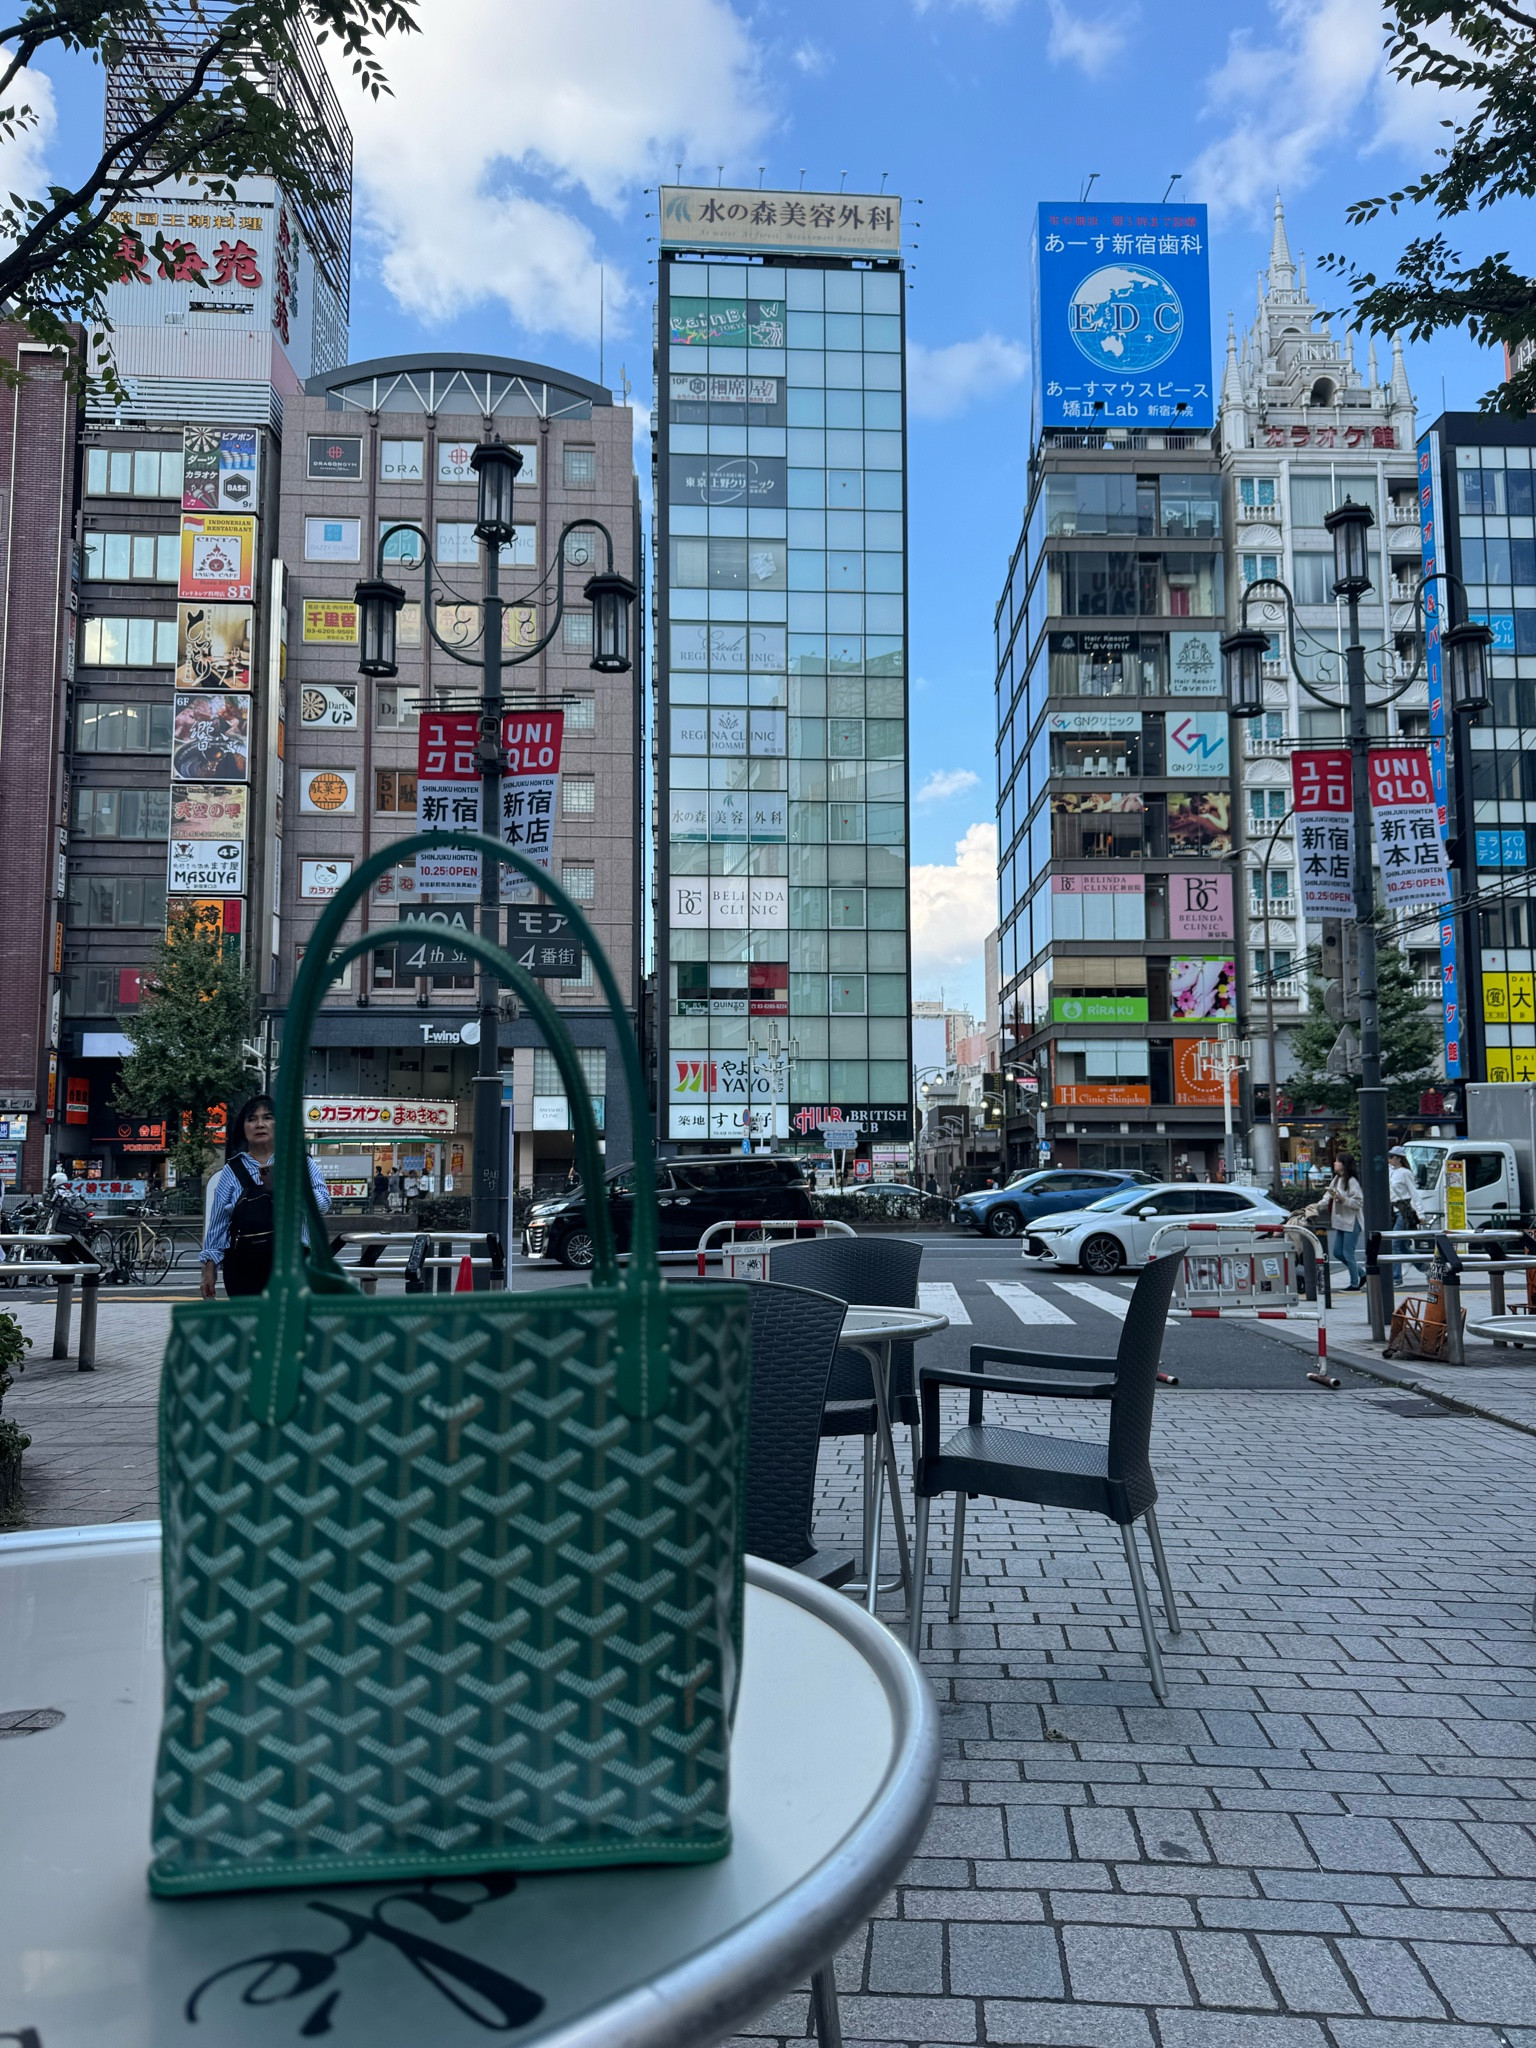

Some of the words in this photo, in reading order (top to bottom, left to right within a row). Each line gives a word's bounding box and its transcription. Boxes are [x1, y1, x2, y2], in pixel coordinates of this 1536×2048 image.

[110, 210, 263, 231] 韓国王朝料理
[698, 198, 895, 232] 水の森美容外科
[1044, 233, 1203, 255] あーす新宿歯科
[1070, 302, 1182, 333] EDC
[1046, 381, 1209, 398] あーすマウスピース
[1104, 402, 1139, 417] Lab
[222, 432, 254, 442] ビアポン
[1265, 426, 1394, 449] カラオケ館
[187, 455, 216, 465] ダーツ
[185, 470, 218, 479] カラオケ
[384, 464, 420, 473] DRA
[441, 466, 476, 475] GON
[227, 484, 247, 492] BASE
[686, 477, 774, 489] 東京上野クリニック
[242, 500, 254, 508] 9F
[227, 585, 251, 599] 8F
[308, 612, 356, 627] 千里香
[1103, 635, 1130, 643] Resort
[1083, 642, 1130, 650] L'avenir
[680, 651, 727, 662] REGINA
[731, 652, 775, 663] CLINIC
[216, 669, 244, 686] 7F
[342, 689, 355, 697] 6F
[1173, 684, 1217, 692] L'avenir
[177, 697, 190, 706] 6F
[328, 701, 349, 710] Darts
[332, 711, 353, 725] UP
[1073, 716, 1134, 727] GNクリニック
[427, 724, 474, 746] ユニ
[507, 723, 553, 744] UNI
[681, 730, 728, 741] REGINA
[731, 731, 775, 741] CLINIC
[711, 741, 746, 750] HOMME
[425, 751, 475, 773] クロ
[505, 747, 554, 772] QLO
[1171, 763, 1224, 772] GNクリニック
[1300, 760, 1344, 782] ユニ
[1373, 758, 1419, 778] UNI
[311, 782, 346, 794] 駄菓子
[422, 785, 453, 793] SHINJUKU
[453, 786, 479, 794] HONTEN
[503, 781, 529, 790] SHINJUKU
[529, 779, 555, 787] HONTEN
[1300, 784, 1345, 805] クロ
[1377, 780, 1427, 802] QLO
[422, 796, 478, 823] 新宿
[503, 789, 552, 818] 新宿
[175, 802, 241, 819] 天空の雫
[671, 809, 783, 825] 水の森美容外科
[503, 817, 551, 847] 本店
[1380, 817, 1435, 842] 新宿
[1301, 826, 1349, 851] 新宿
[1478, 836, 1512, 847] ミライ
[218, 847, 240, 857] 4F
[420, 853, 452, 861] SHINJUKU
[453, 854, 478, 862] HONTEN
[1383, 842, 1439, 867] 本店
[1478, 849, 1525, 861] デンタル
[420, 865, 446, 876] 10.25
[448, 866, 478, 877] OPEN
[1303, 853, 1350, 879] 本店
[175, 871, 237, 884] MASUYA
[1385, 869, 1417, 879] SHINJUKU
[1417, 867, 1443, 875] HONTEN
[1083, 876, 1127, 884] BELINDA
[1387, 880, 1413, 892] 10.25
[1416, 878, 1445, 888] OPEN
[713, 891, 785, 901] BELINDA
[1305, 891, 1328, 901] 10.25
[1329, 892, 1351, 902] OPEN
[719, 905, 778, 915] CLINIC
[518, 912, 569, 934] モア
[1183, 923, 1219, 931] CLINIC
[517, 943, 574, 970] 4番街
[1512, 987, 1532, 1008] 大
[420, 1024, 460, 1044] T-wing
[722, 1078, 770, 1093] YAYO
[1079, 1093, 1105, 1104] Clinic
[1107, 1092, 1146, 1105] Shinjuku
[1187, 1094, 1207, 1103] Clinic
[320, 1106, 382, 1121] カラオケ
[392, 1105, 448, 1126] まねきねこ
[678, 1115, 705, 1126] 築地
[851, 1110, 907, 1121] BRITISH
[860, 1122, 879, 1133] UB
